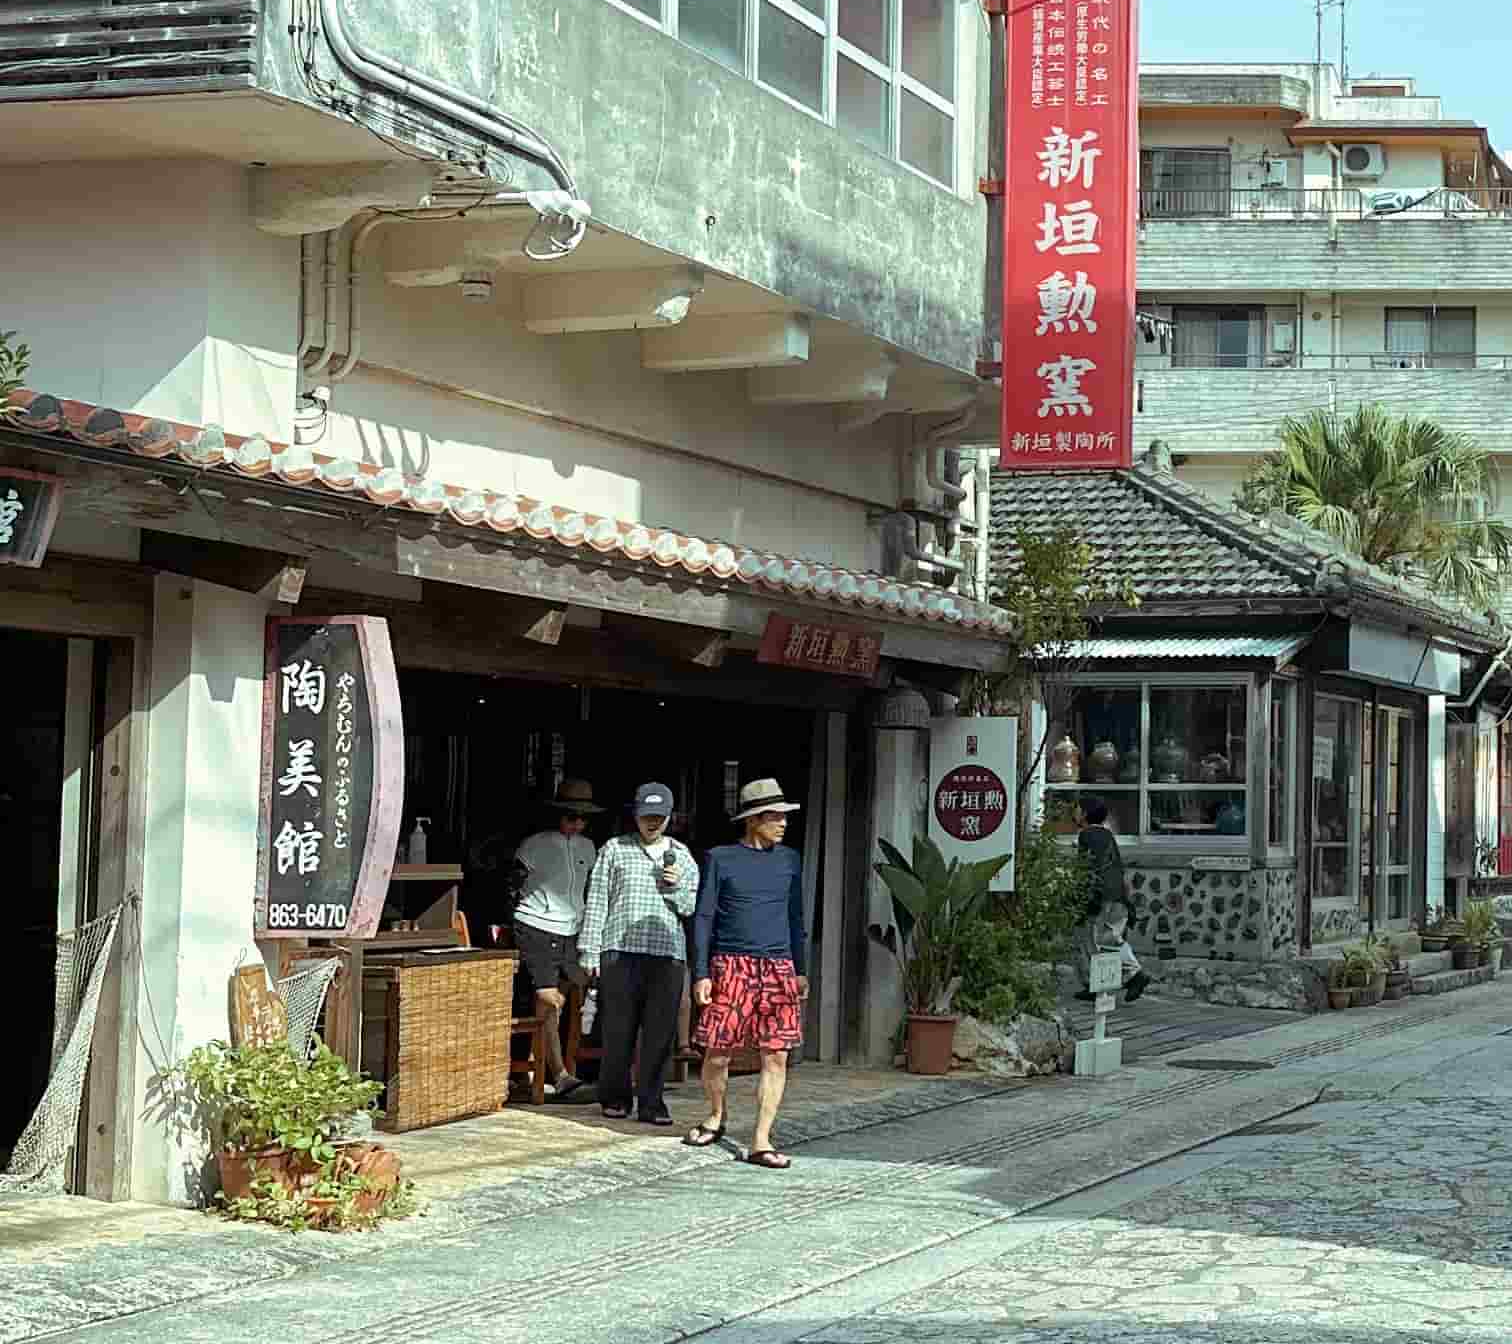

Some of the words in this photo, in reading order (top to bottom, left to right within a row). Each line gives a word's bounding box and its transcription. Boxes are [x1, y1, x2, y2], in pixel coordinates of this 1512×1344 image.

[1035, 126, 1103, 418] 新垣勲窯
[1011, 430, 1117, 453] 新垣製陶所
[273, 658, 326, 876] 陶美館
[269, 903, 347, 928] 863-6470
